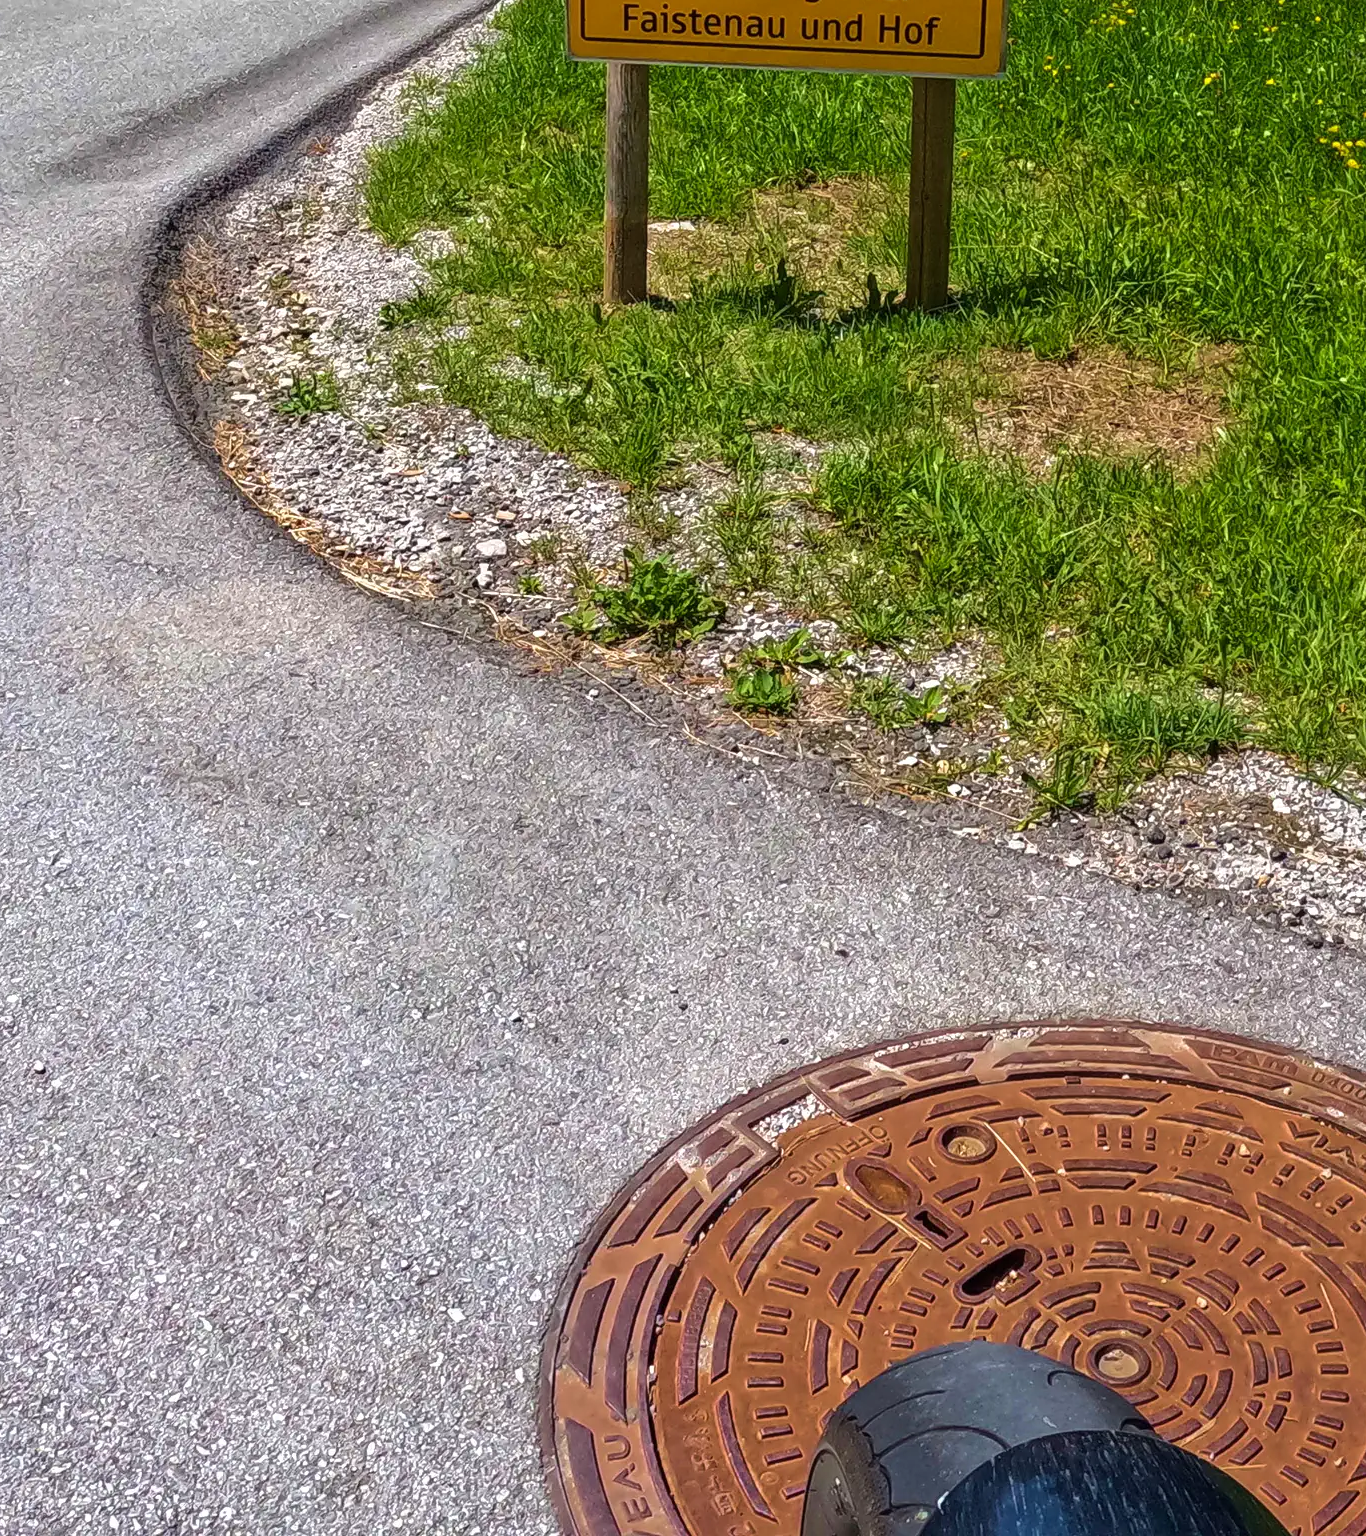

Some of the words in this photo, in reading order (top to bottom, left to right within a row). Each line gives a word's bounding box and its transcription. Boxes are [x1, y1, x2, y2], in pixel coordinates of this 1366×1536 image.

[622, 3, 786, 39] Faistenau
[801, 13, 863, 42] und
[878, 14, 941, 46] Hof
[787, 1125, 892, 1185] ÖFFNUNG
[604, 1433, 665, 1536] EAU
